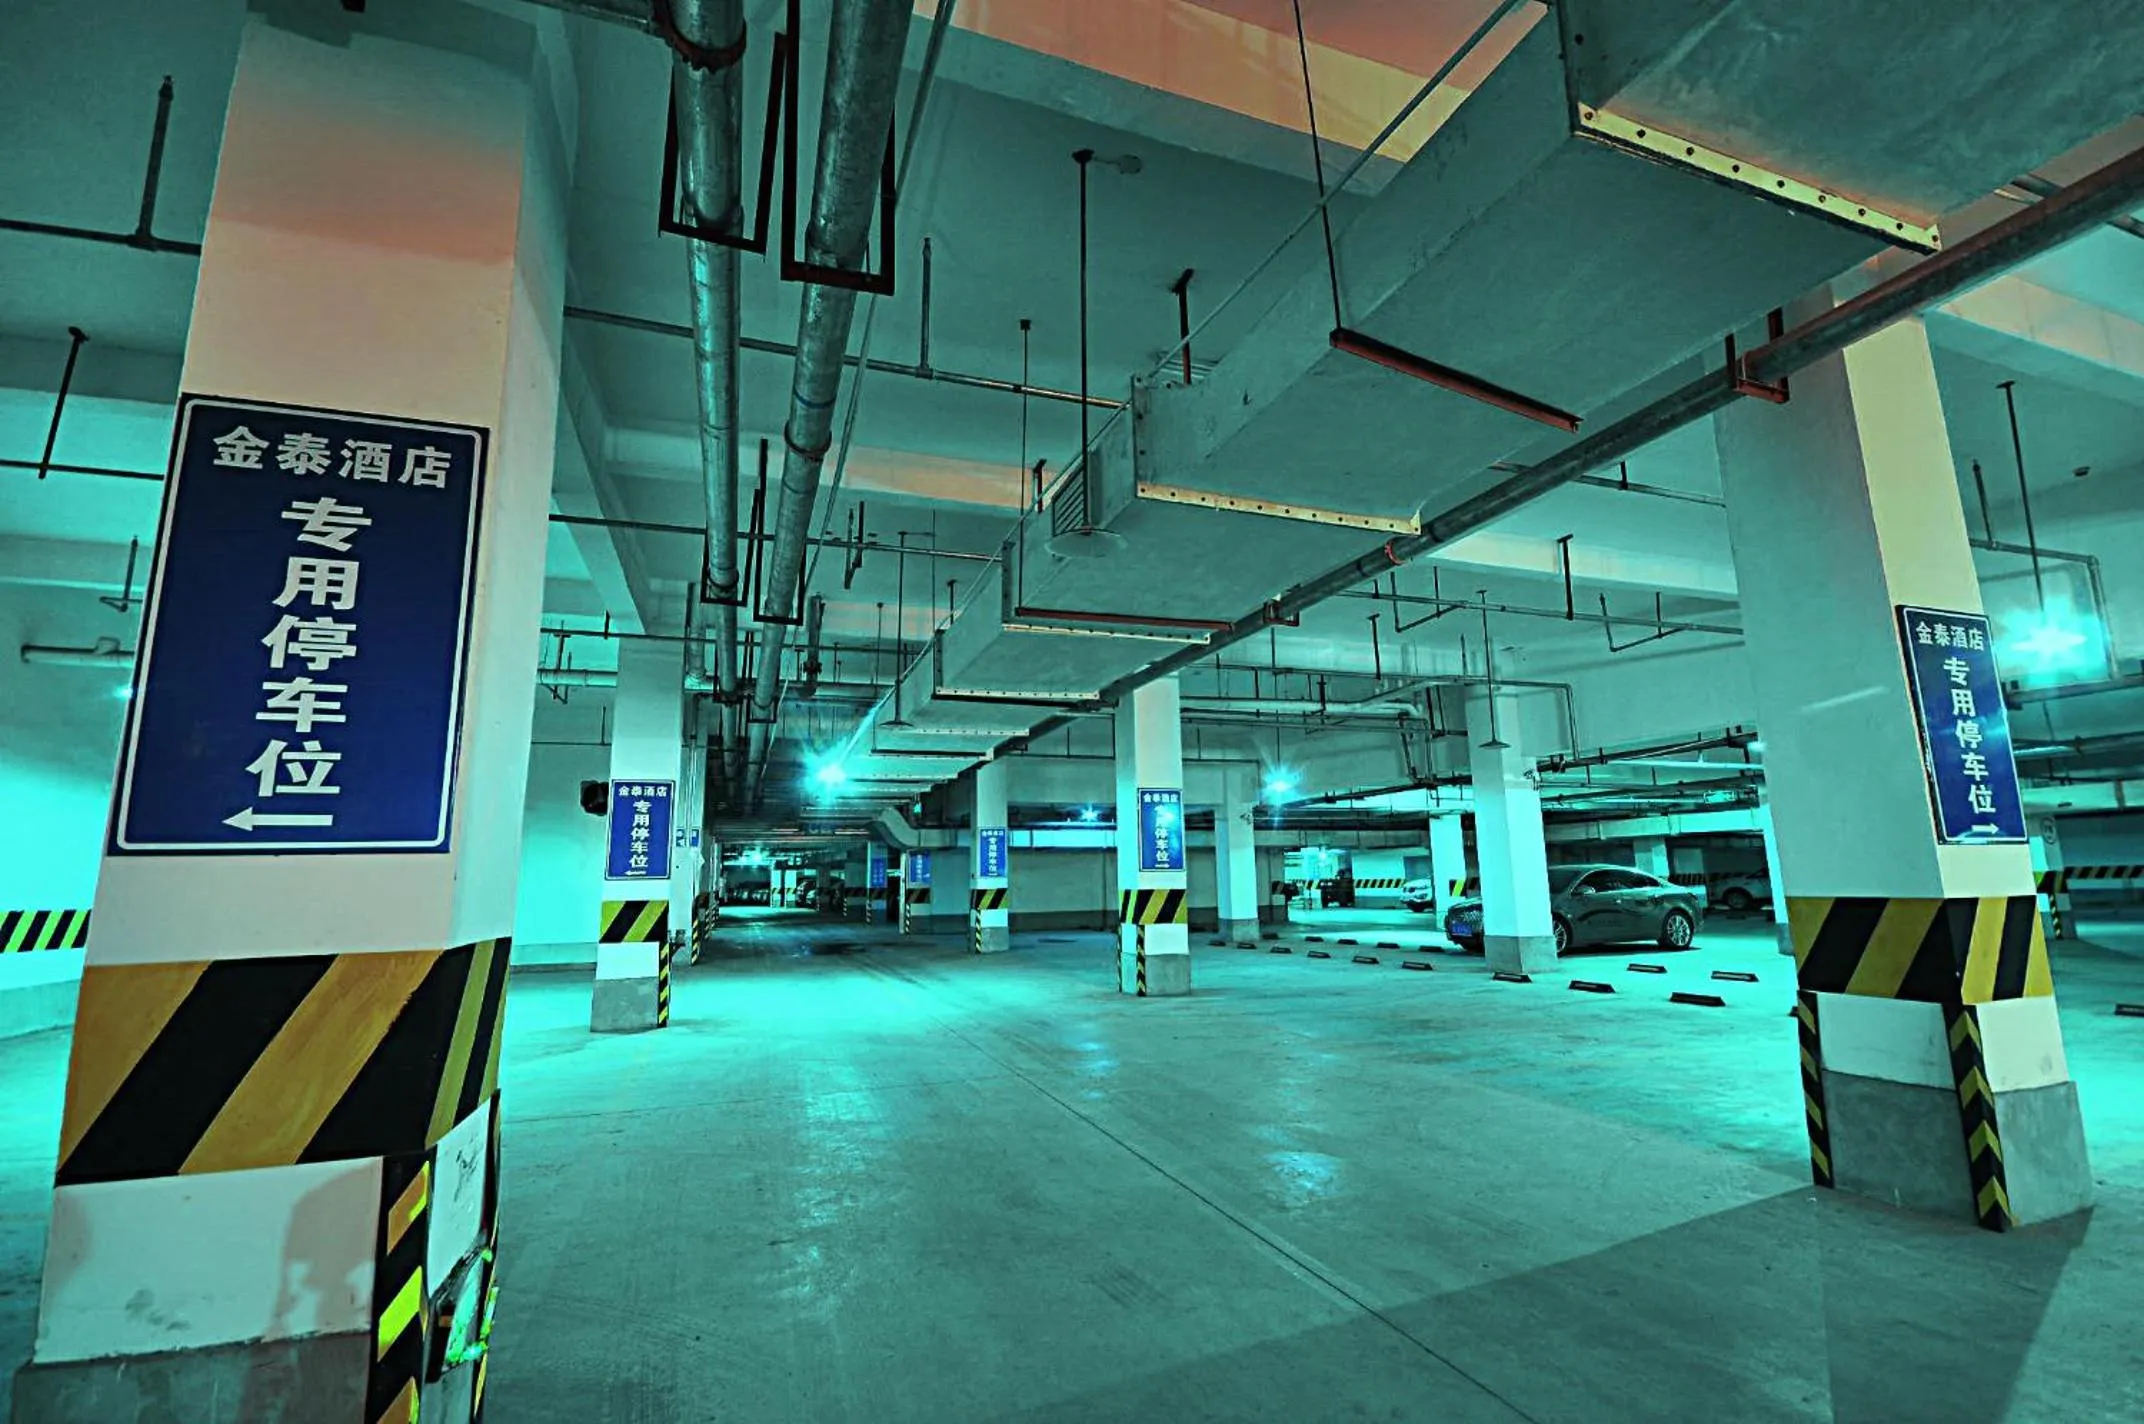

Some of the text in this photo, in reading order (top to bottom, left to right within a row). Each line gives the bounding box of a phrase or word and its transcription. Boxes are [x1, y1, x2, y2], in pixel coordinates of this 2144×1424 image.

[213, 426, 452, 488] 金泰酒店
[246, 497, 372, 797] 专用停车位
[1916, 621, 1984, 651] 金泰酒店
[1944, 657, 1996, 814] 专用停车位
[630, 800, 651, 867] 专用停车位
[1154, 805, 1169, 861] 停车位
